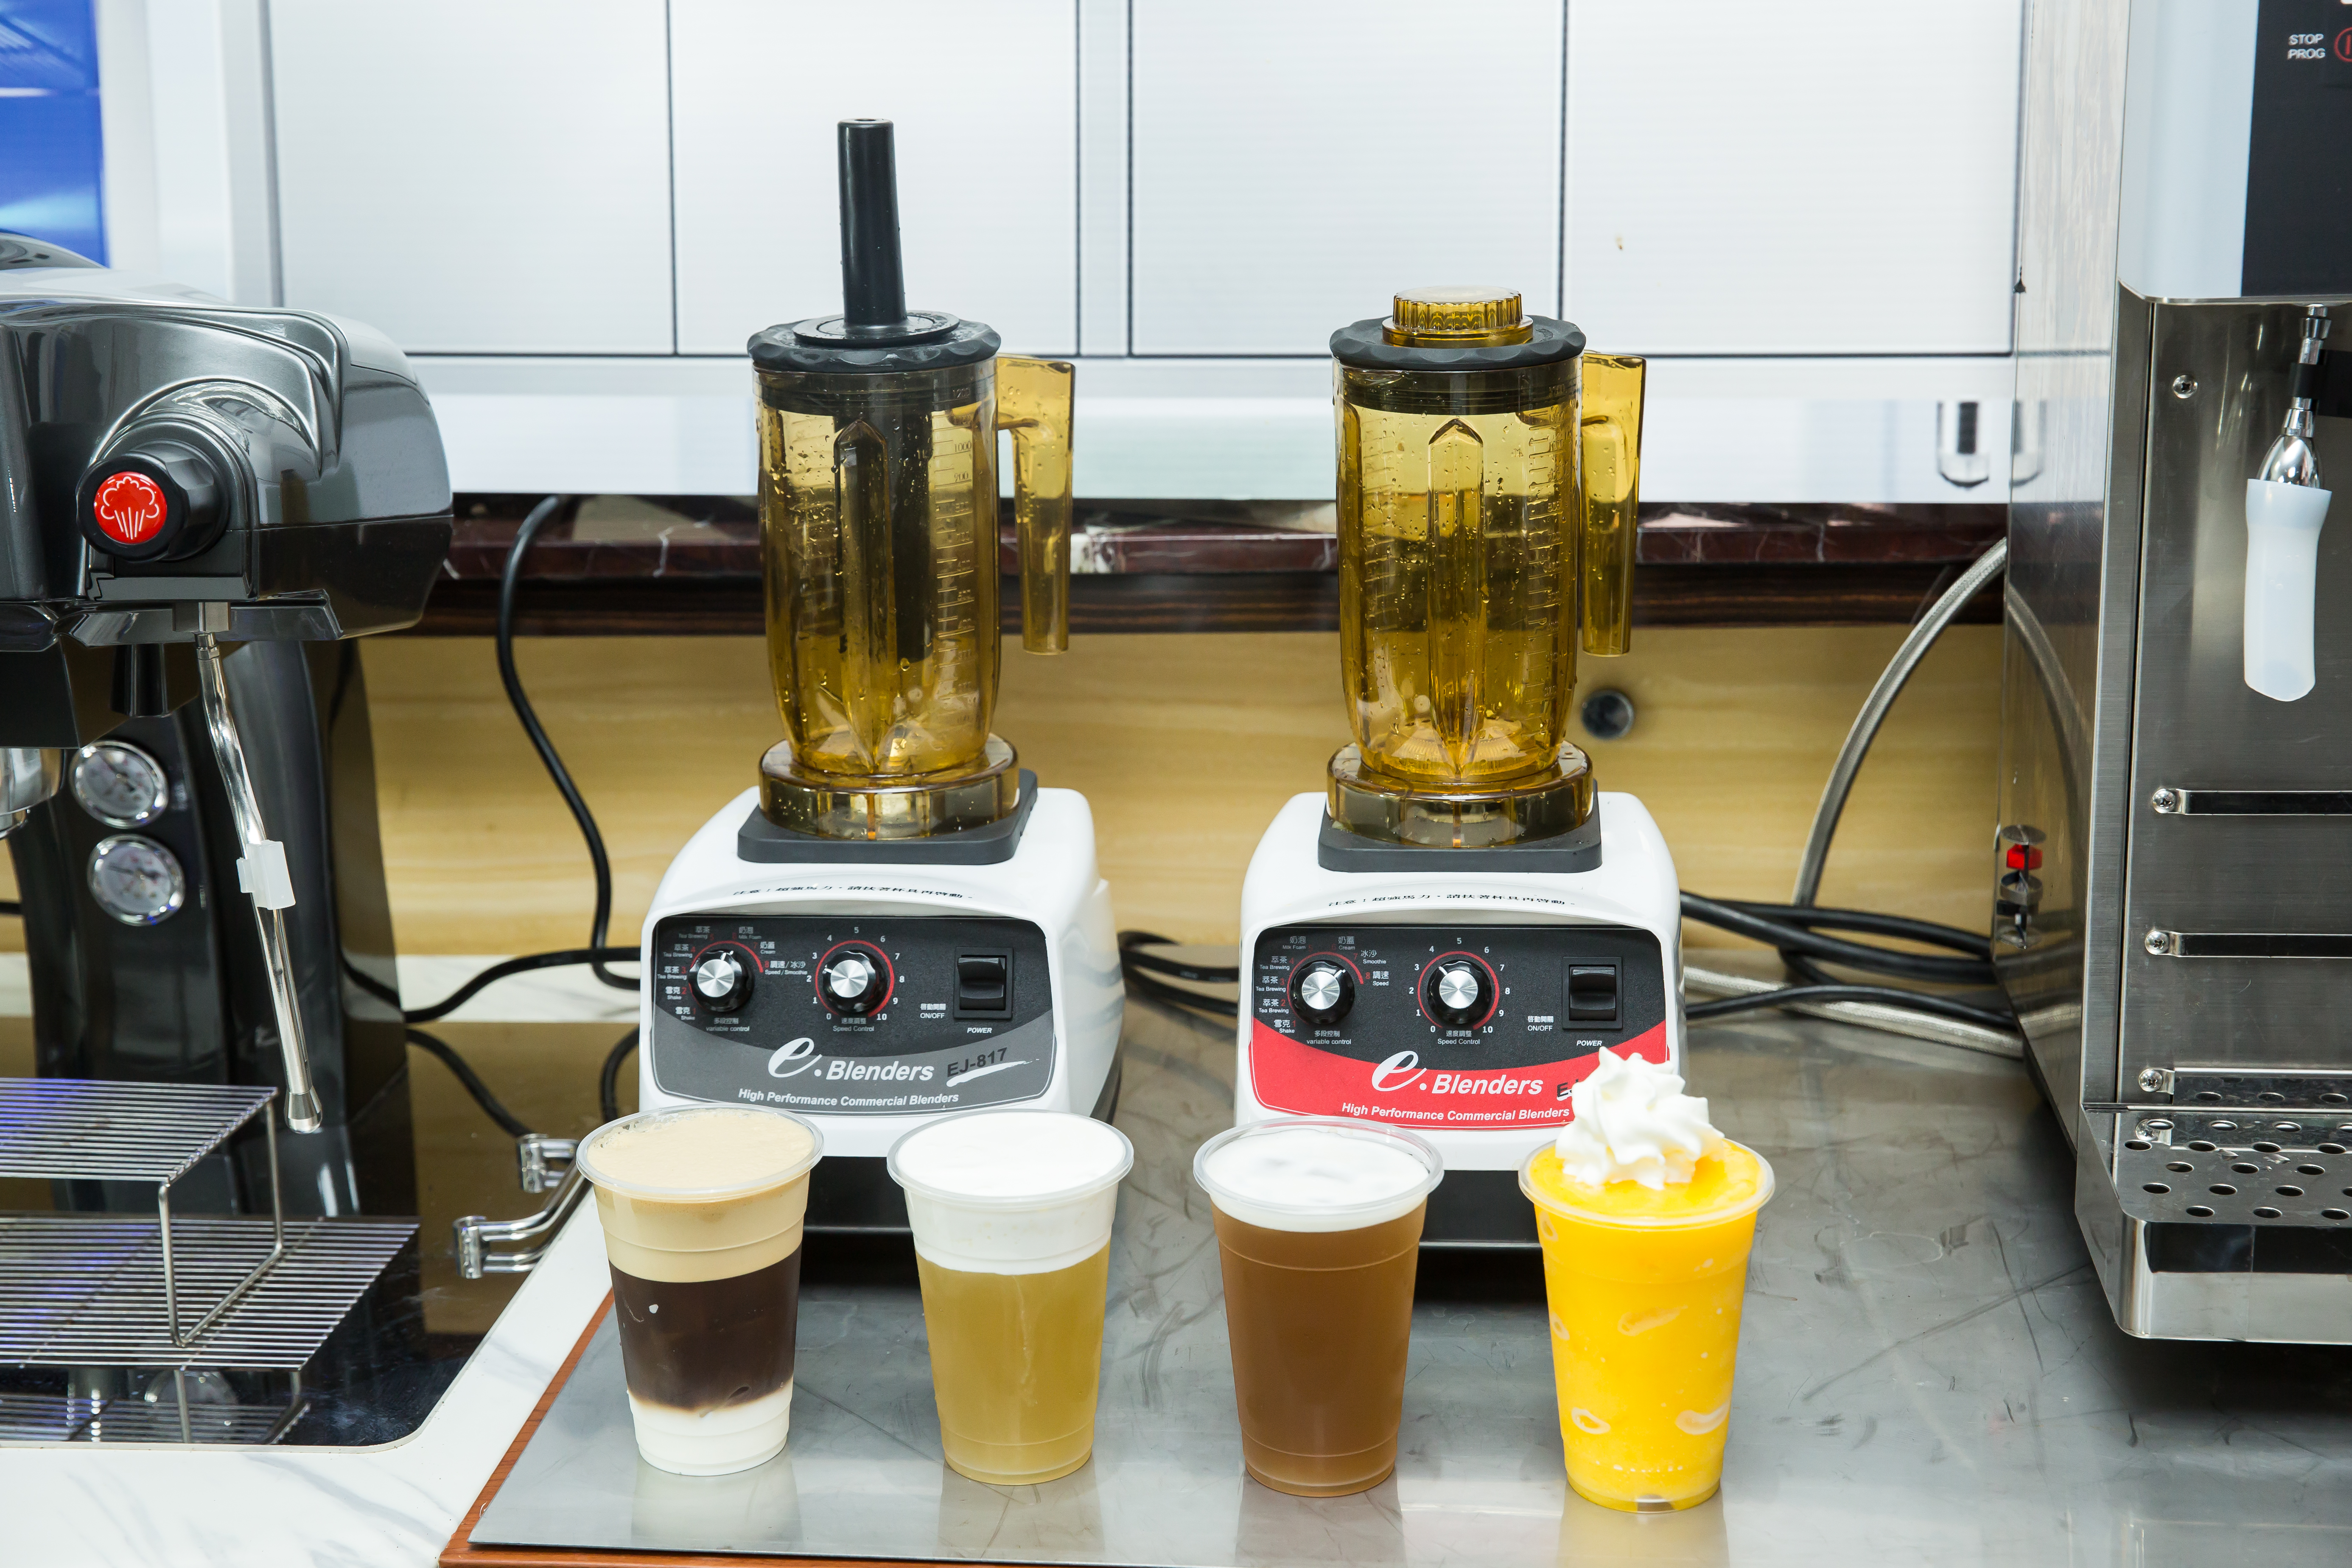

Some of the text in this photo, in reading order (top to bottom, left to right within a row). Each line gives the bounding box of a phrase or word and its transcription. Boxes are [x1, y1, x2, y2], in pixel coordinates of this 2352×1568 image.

[2288, 34, 2324, 45] STOP
[2287, 48, 2326, 60] PROG
[1290, 936, 1306, 944] 奶泡
[1338, 936, 1355, 944] 奶蓋
[1361, 949, 1377, 958] 冰沙
[1372, 971, 1389, 979] 調速
[681, 987, 687, 995] 2
[1274, 1019, 1290, 1028] 雪克
[947, 1047, 1007, 1077] EJ-817
[738, 1088, 959, 1106] High Performance Commercial Blenders
[1342, 1102, 1570, 1120] High Performance Commercial Blenders
